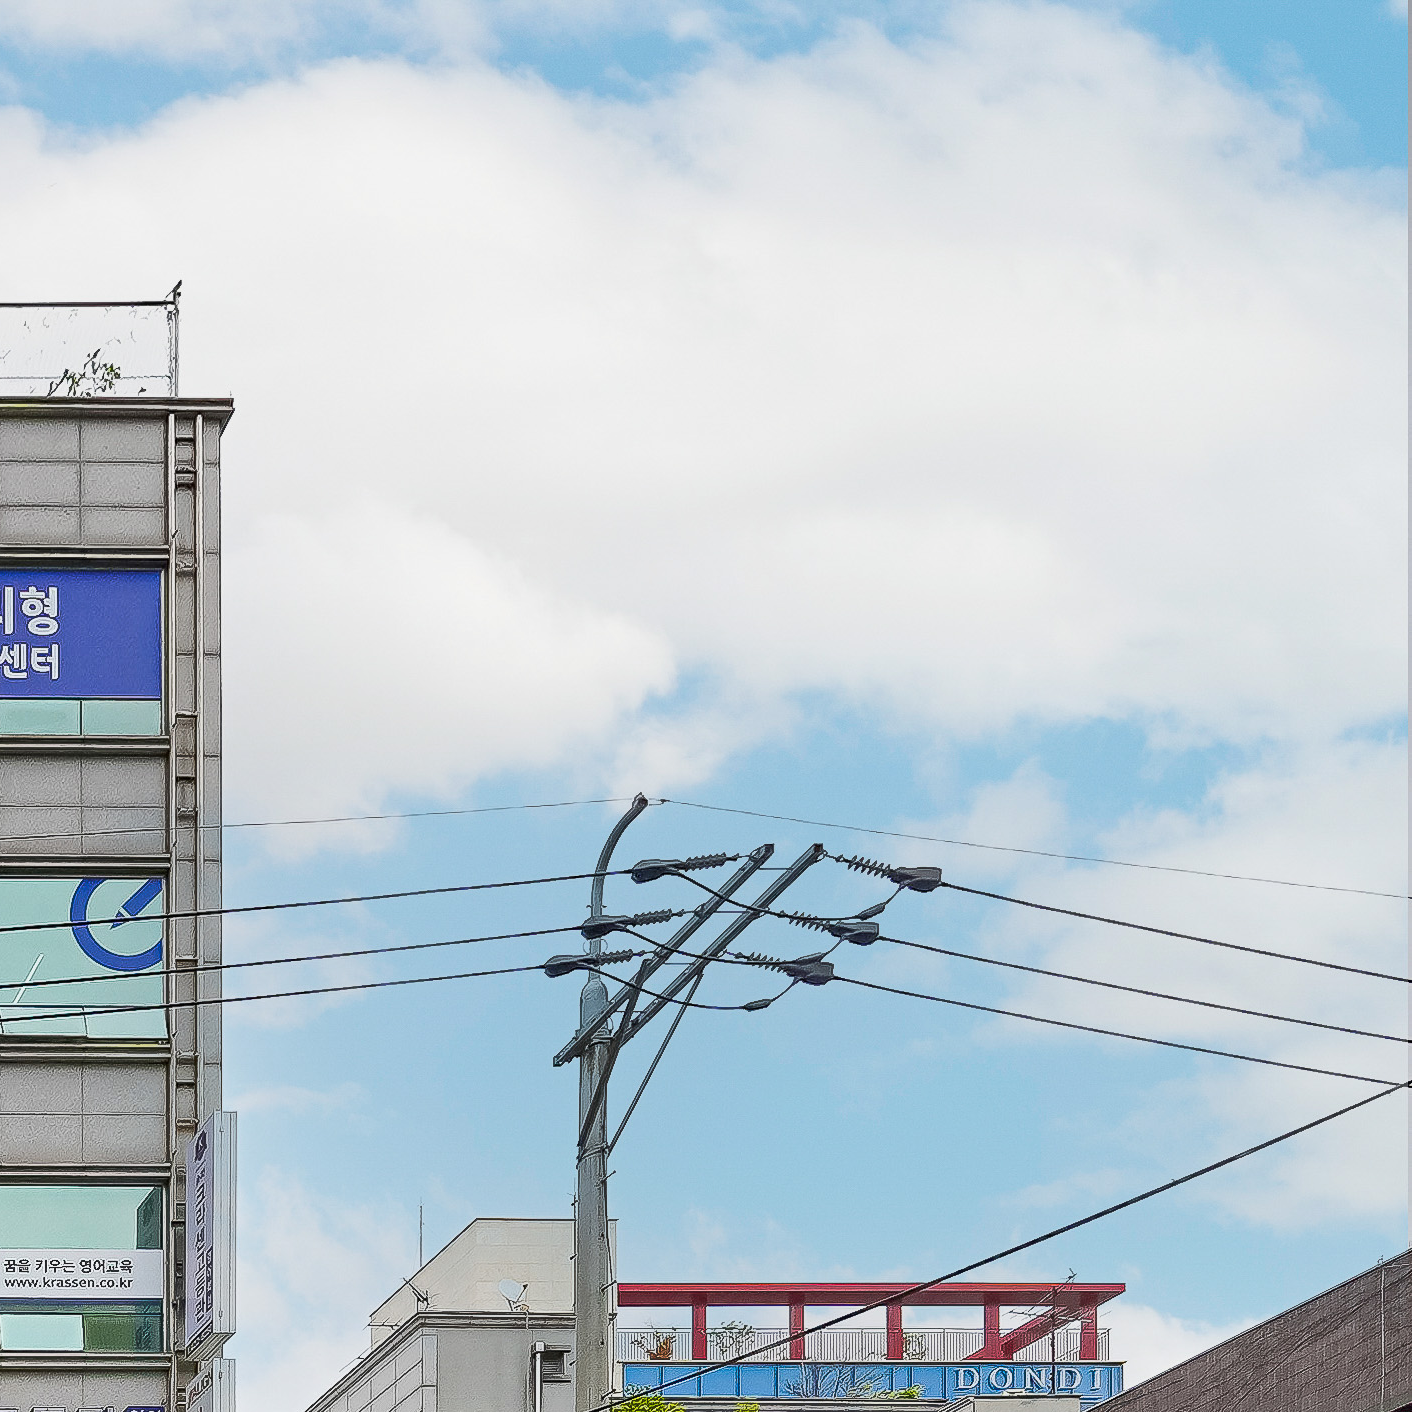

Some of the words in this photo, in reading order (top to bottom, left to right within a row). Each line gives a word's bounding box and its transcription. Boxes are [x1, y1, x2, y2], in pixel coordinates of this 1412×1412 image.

[4, 1259, 31, 1273] 꿈을
[36, 1260, 75, 1273] 키우는
[79, 1259, 133, 1273] 영어교육
[5, 1277, 133, 1288] www.krassen.co.kr
